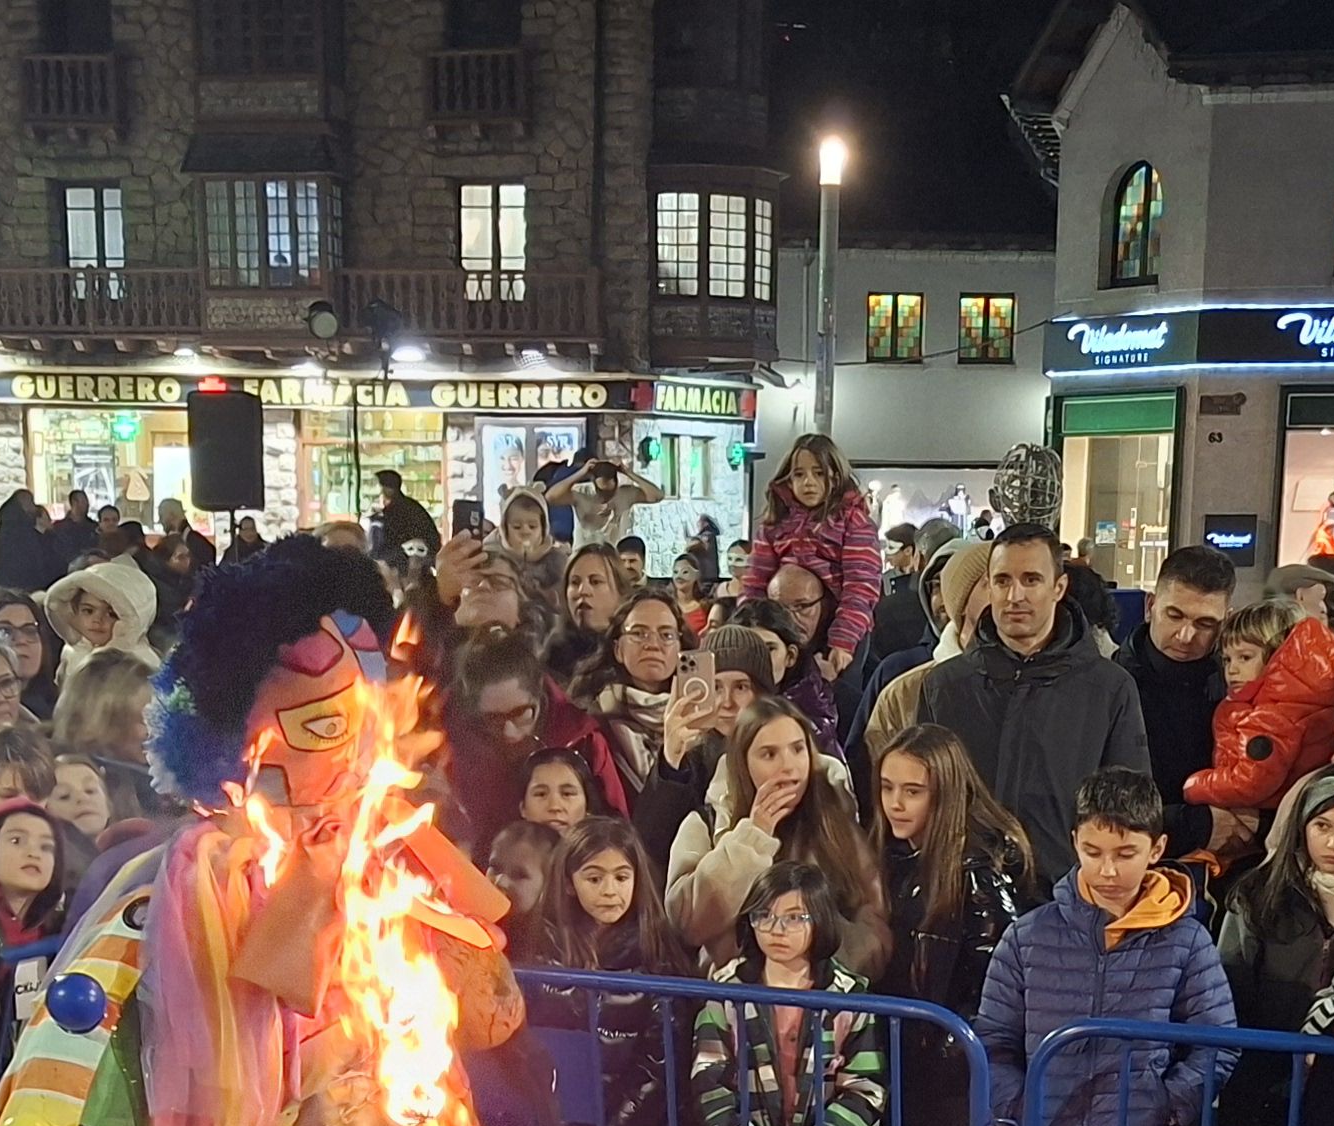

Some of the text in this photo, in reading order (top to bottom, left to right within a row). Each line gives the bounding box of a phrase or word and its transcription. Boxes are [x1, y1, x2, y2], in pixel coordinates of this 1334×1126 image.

[1068, 321, 1168, 354] Viladomat
[1095, 353, 1149, 365] SIGNATURE
[11, 375, 181, 402] GUERRERO
[430, 382, 608, 408] GUERRERO
[1208, 432, 1223, 443] 63
